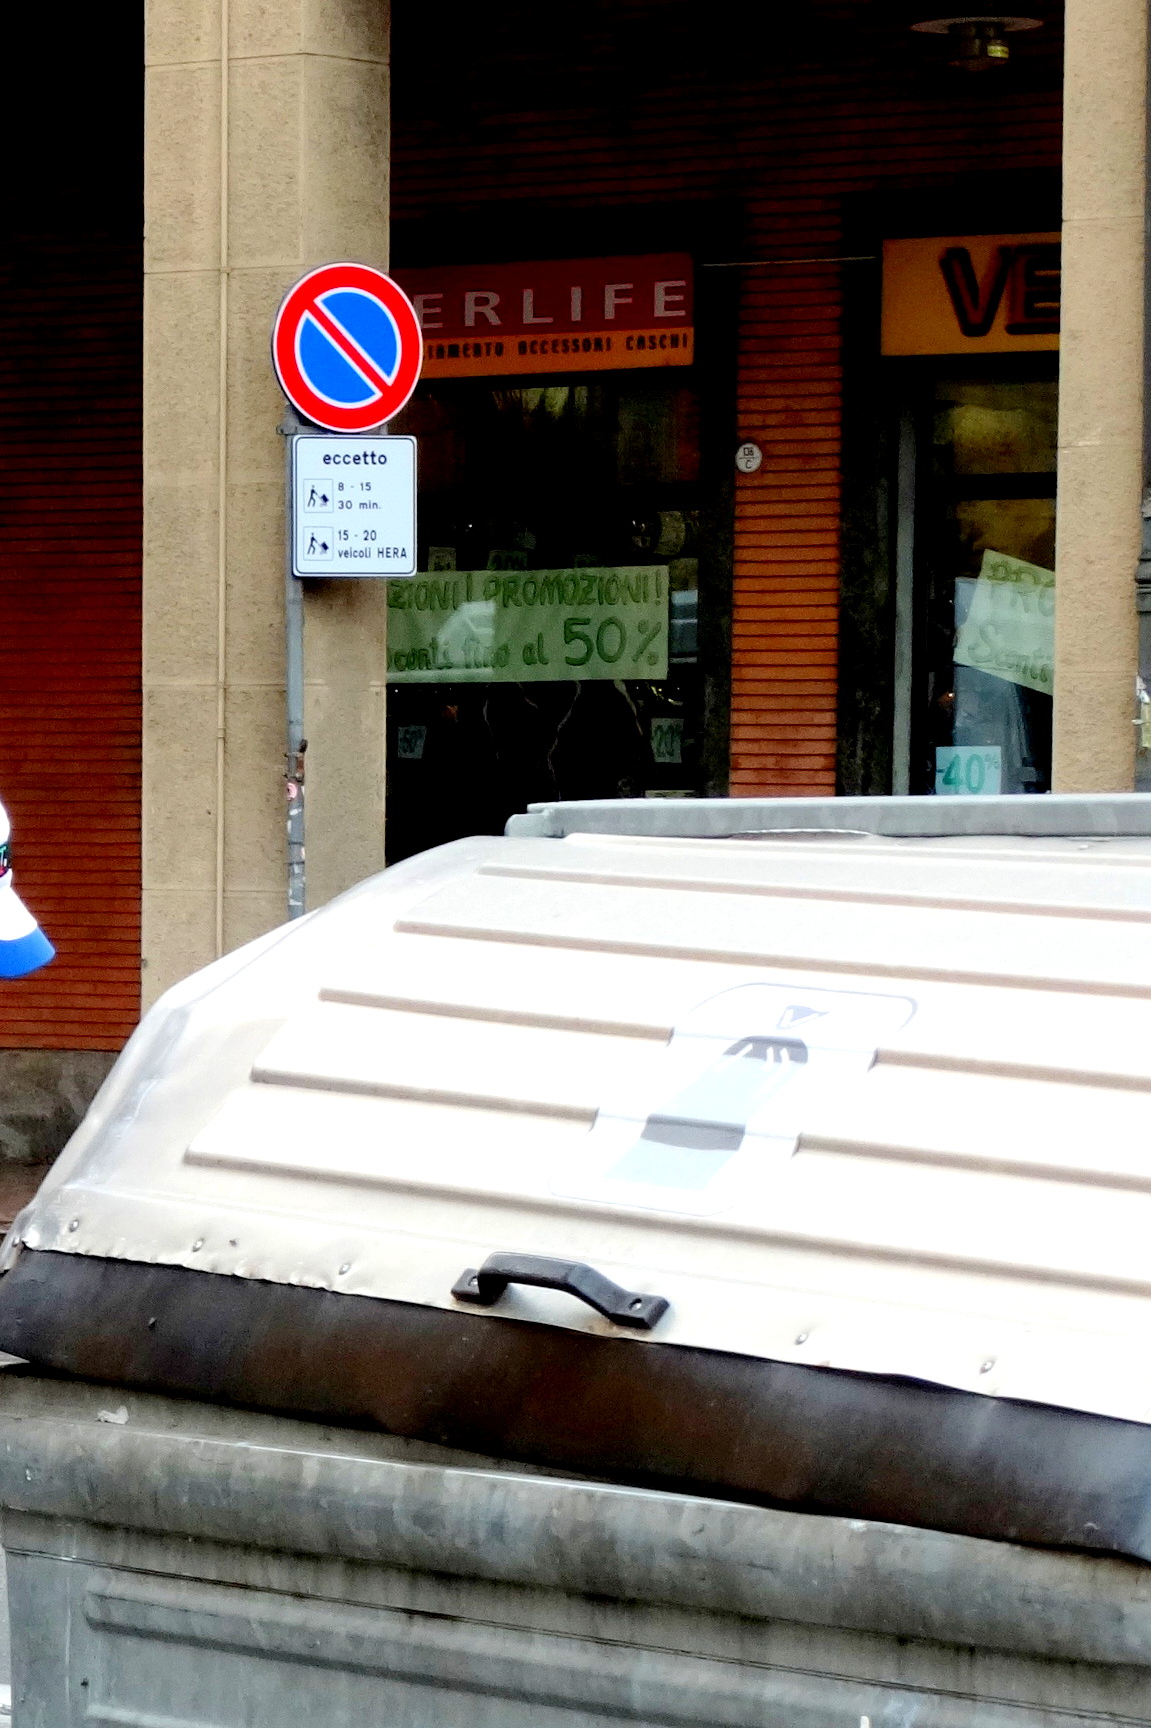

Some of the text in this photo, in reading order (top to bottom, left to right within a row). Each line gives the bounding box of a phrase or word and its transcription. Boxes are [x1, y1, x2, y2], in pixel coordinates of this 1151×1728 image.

[422, 332, 688, 360] IAMENTO ACCESSORI CASCHI
[323, 451, 387, 465] eccetto
[338, 482, 344, 491] 8
[360, 482, 372, 491] 15
[338, 500, 381, 509] 30 min.
[338, 530, 349, 540] 15
[363, 530, 377, 540] 20
[338, 547, 407, 558] veicoli HERA
[483, 569, 662, 609] PROMOZIONI!
[522, 633, 549, 665] al
[563, 616, 661, 666] 50%
